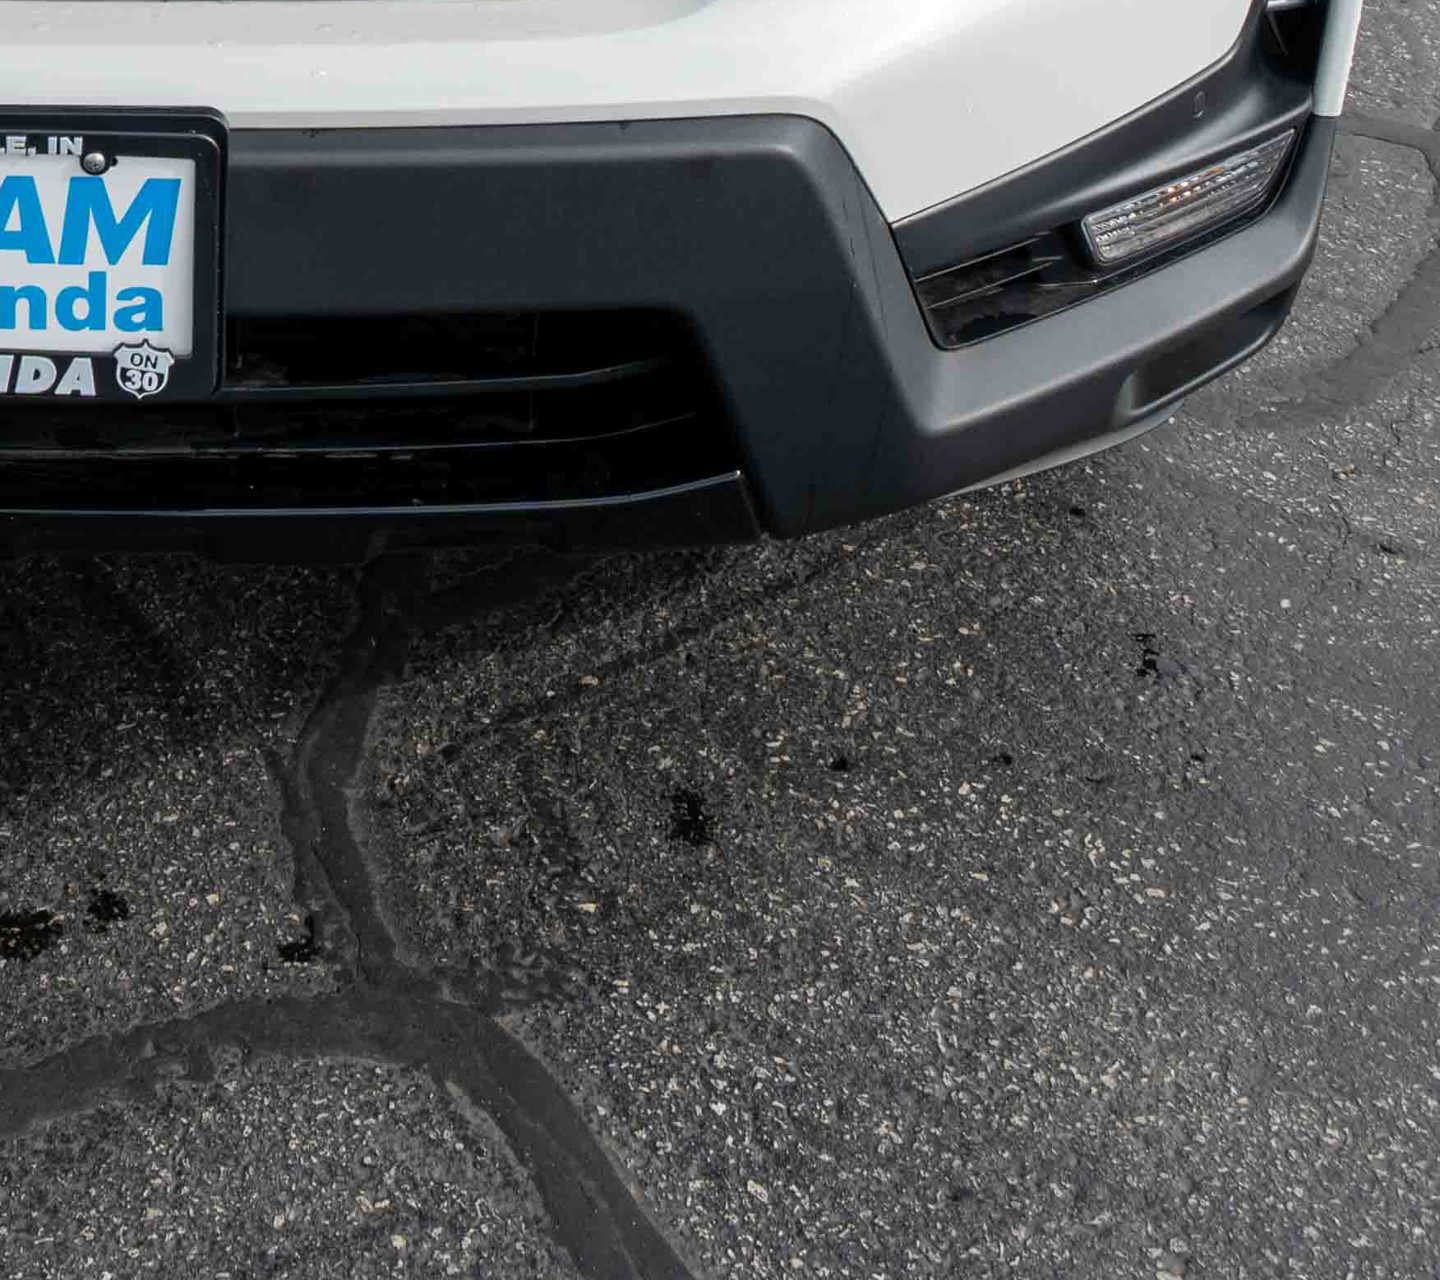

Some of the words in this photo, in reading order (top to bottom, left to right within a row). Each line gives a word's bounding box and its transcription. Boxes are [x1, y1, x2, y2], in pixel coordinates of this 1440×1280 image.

[47, 135, 83, 156] IN
[130, 352, 159, 370] ON
[125, 368, 159, 392] 30
